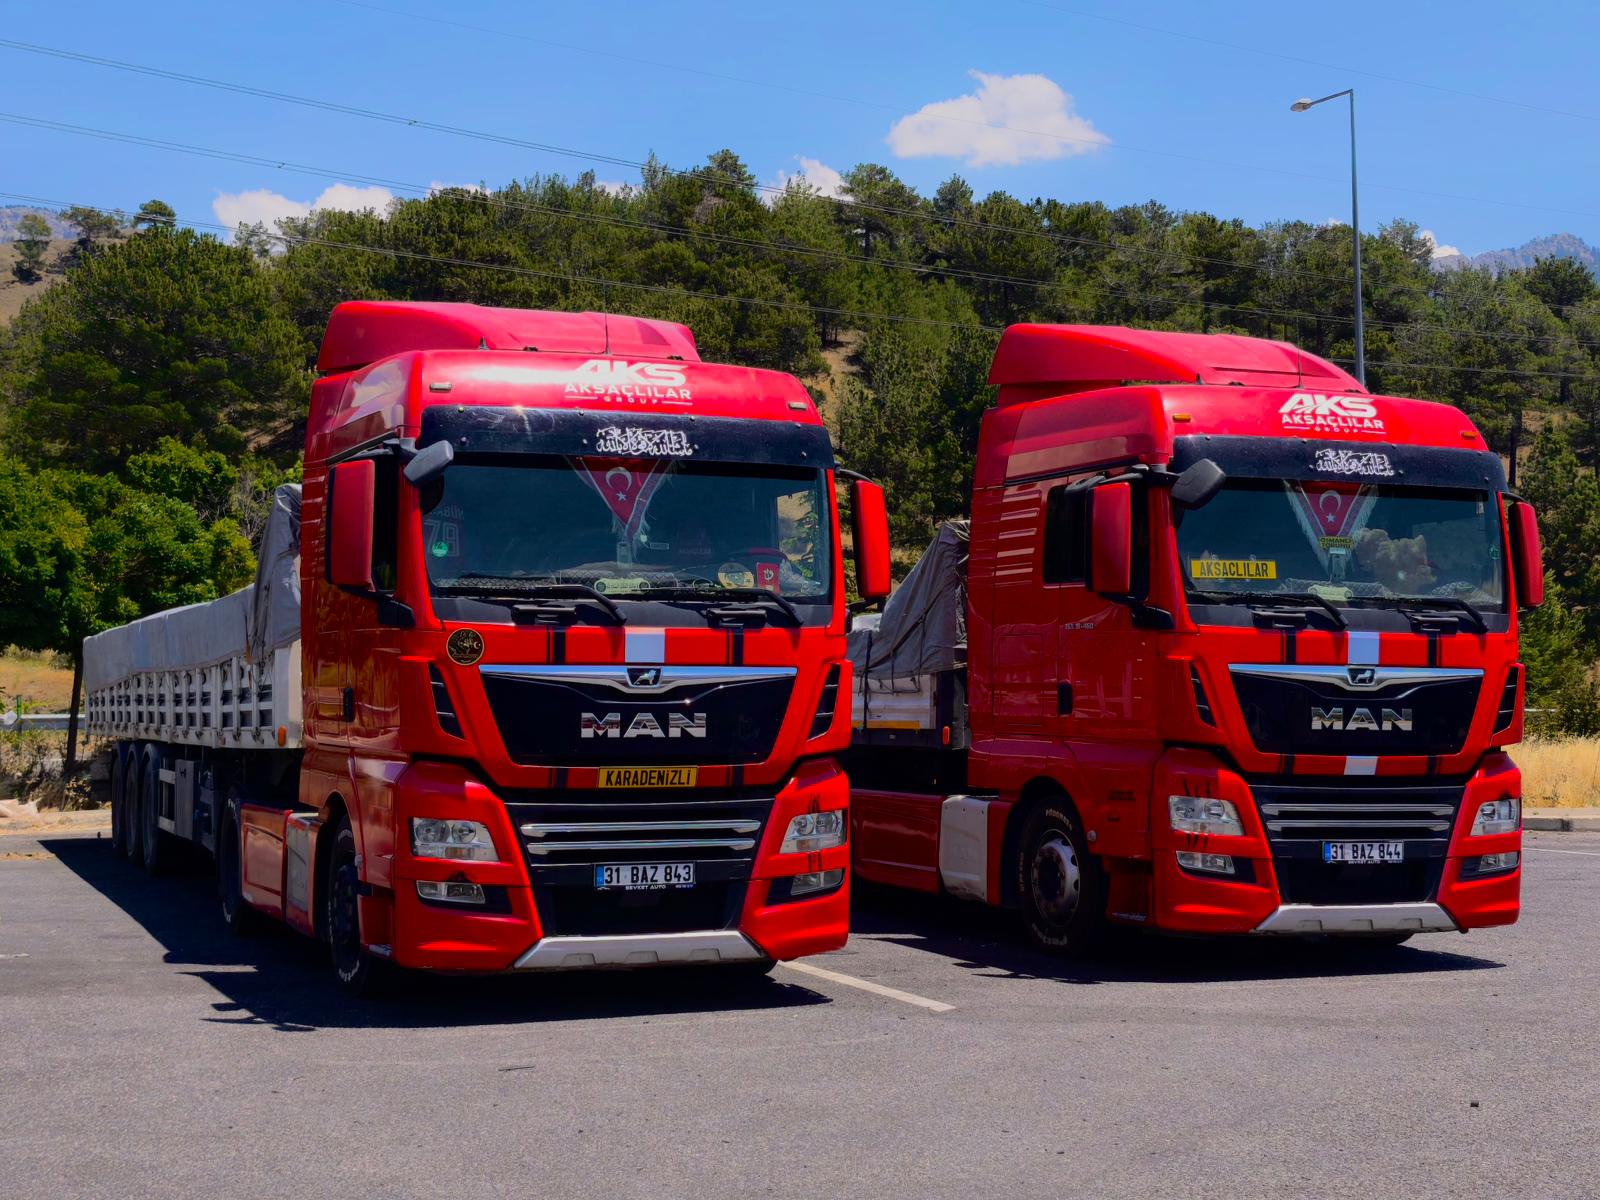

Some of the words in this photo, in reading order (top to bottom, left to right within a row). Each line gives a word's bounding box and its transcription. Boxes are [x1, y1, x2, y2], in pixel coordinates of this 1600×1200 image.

[564, 359, 688, 386] AKS
[565, 383, 692, 400] AKSAÇLILAR
[603, 395, 658, 404] GROUP
[1278, 393, 1377, 418] AKS
[1281, 414, 1384, 430] AKSAÇLILAR
[1200, 562, 1268, 577] AKSACLILAR
[580, 712, 707, 738] MAN
[1311, 706, 1413, 731] MAN
[1331, 844, 1344, 859] 31
[1351, 844, 1374, 859] BAZ
[1379, 844, 1400, 859] 844
[604, 866, 620, 884] 31
[630, 866, 659, 883] BAZ
[664, 865, 691, 882] 843
